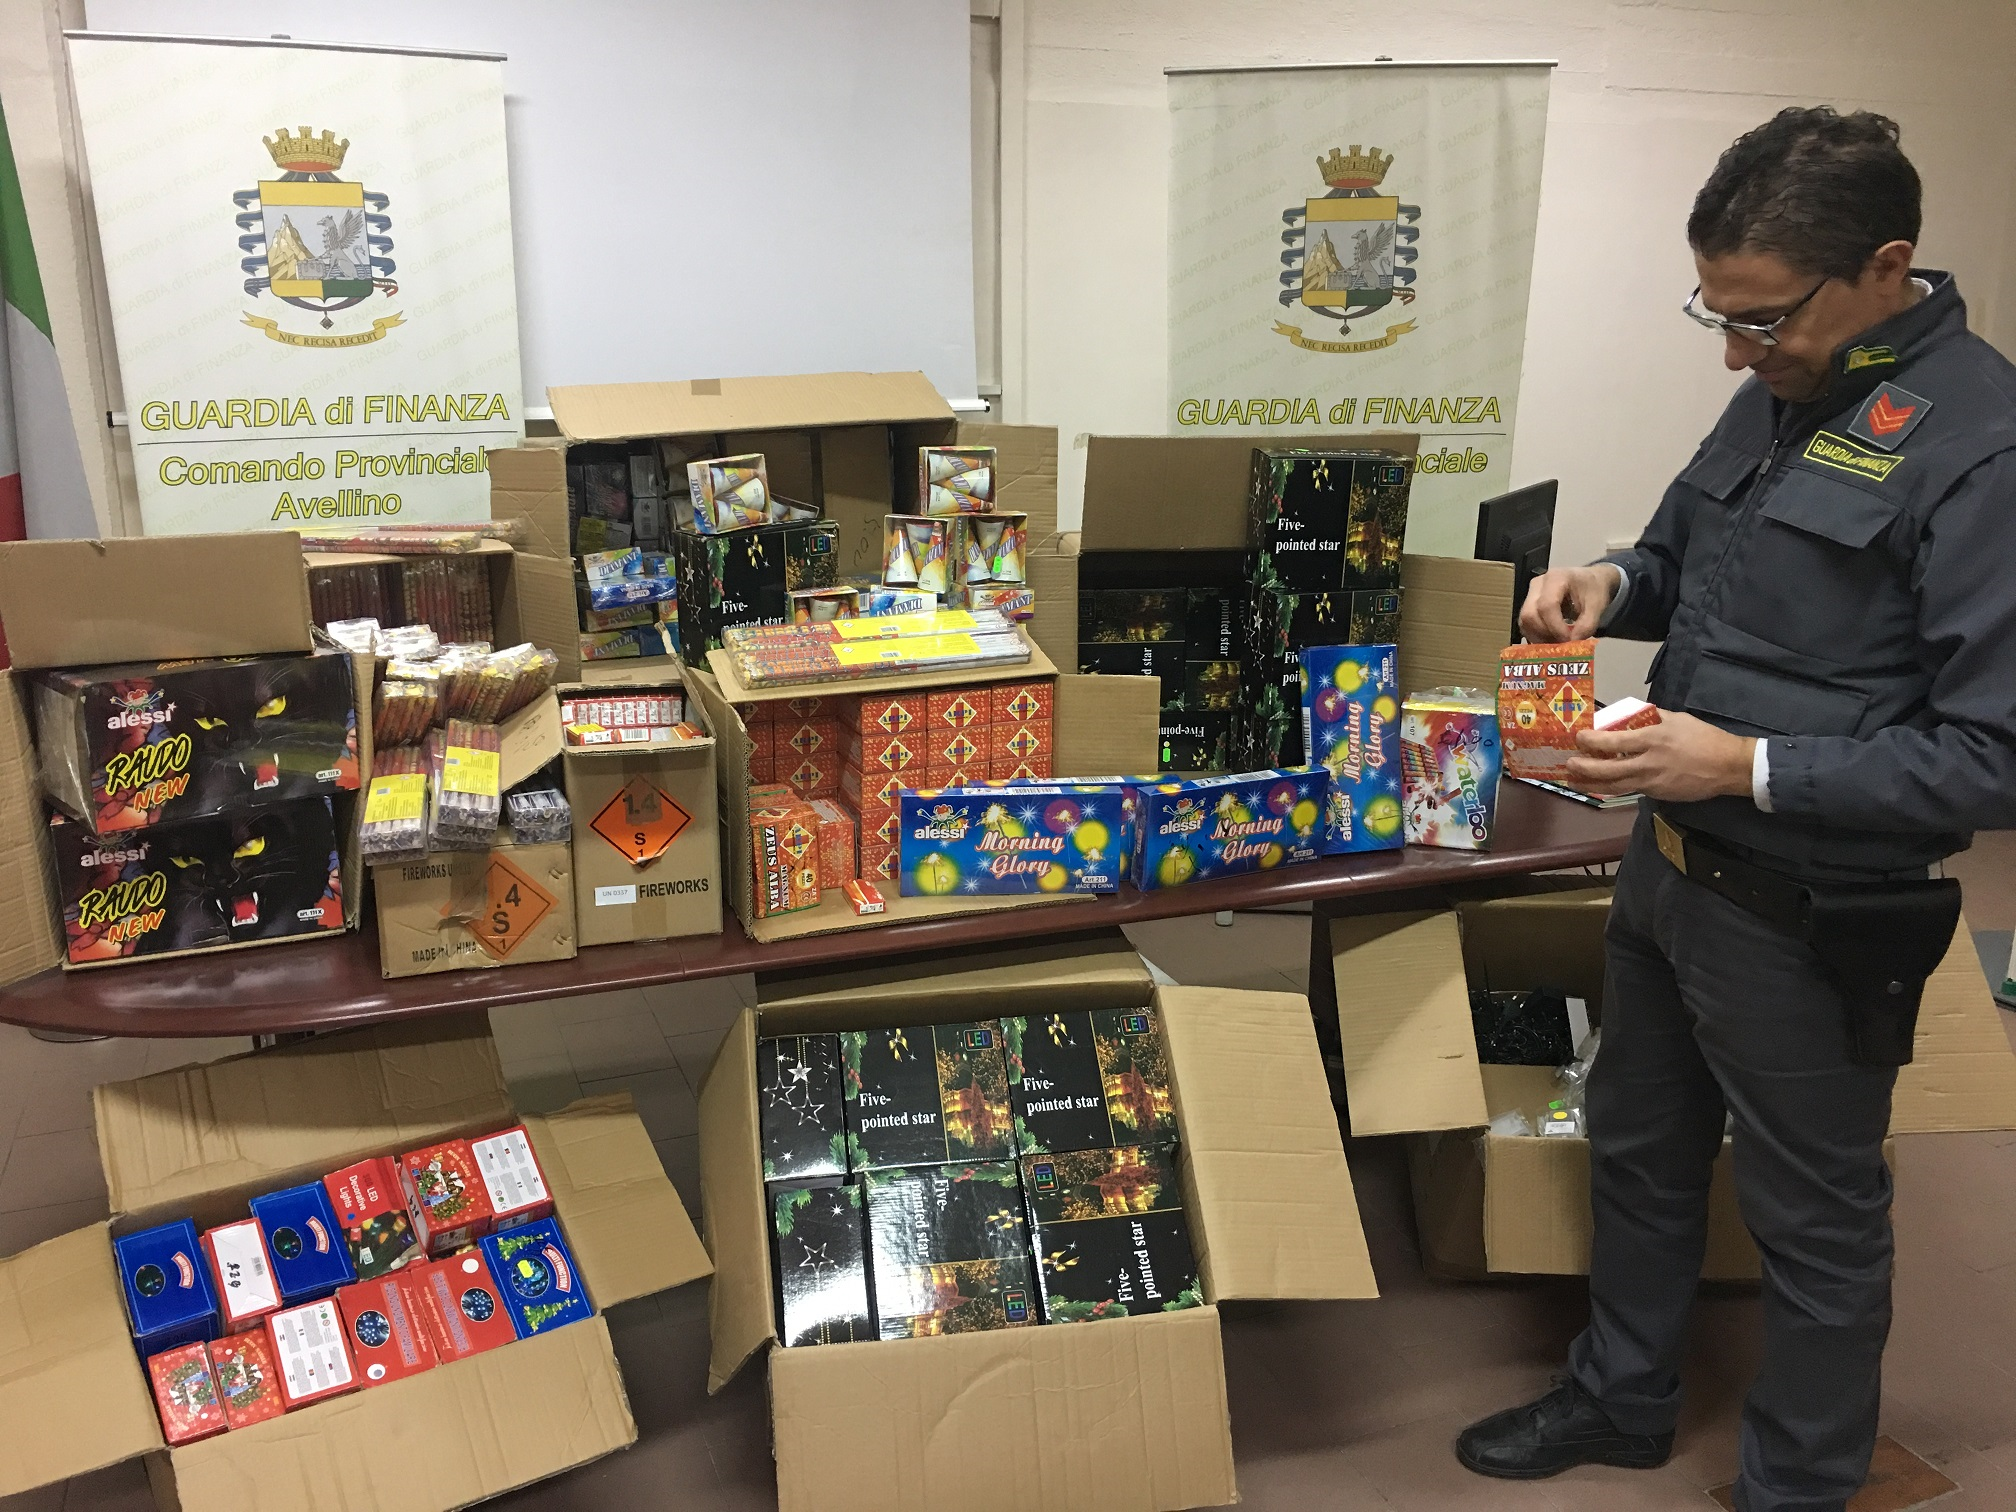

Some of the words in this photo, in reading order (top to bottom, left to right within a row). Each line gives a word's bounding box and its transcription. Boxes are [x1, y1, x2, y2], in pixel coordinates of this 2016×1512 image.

[278, 331, 298, 345] NEC
[302, 336, 337, 348] RECISA
[340, 330, 378, 346] RECEDIT
[1300, 338, 1318, 350] NEC
[1321, 342, 1351, 353] RECISA
[1353, 338, 1389, 352] RECEDIT
[141, 397, 315, 431] GUARDIA
[324, 398, 354, 426] di
[364, 393, 510, 426] FINANZA
[1177, 398, 1321, 425] GUARDIA
[1328, 398, 1356, 425] di
[1363, 397, 1502, 424] FINANZA
[1812, 439, 1853, 464] GUARDIA
[159, 451, 324, 486] Comando
[272, 489, 402, 521] Avellino
[1277, 518, 1305, 531] Five-
[1275, 538, 1316, 554] pointed
[1318, 538, 1341, 551] star
[598, 551, 637, 576] DIAMANT
[722, 600, 748, 614] Five-
[1219, 600, 1232, 635] pointed
[764, 616, 784, 626] star
[1142, 646, 1153, 666] star
[1220, 637, 1229, 657] star
[1284, 651, 1300, 664] Fiv
[1504, 664, 1544, 677] ALBA
[1547, 662, 1589, 676] ZEUS
[1502, 680, 1546, 690] MAGNUM
[107, 706, 174, 730] alessi
[1521, 714, 1532, 725] 40
[1342, 701, 1364, 784] Morning
[1364, 712, 1386, 769] Glory
[105, 733, 192, 795] RAUDO
[134, 772, 190, 812] NEW
[622, 793, 658, 814] 1.4
[1159, 819, 1202, 835] alessi
[1210, 814, 1284, 840] Morning
[1340, 793, 1352, 841] alessi
[634, 832, 646, 846] S
[914, 824, 967, 840] alessi
[975, 830, 1065, 854] Morning
[80, 846, 148, 867] alessi
[638, 848, 644, 857] 1
[765, 826, 778, 866] ZEUS
[1221, 840, 1272, 865] Glory
[402, 864, 447, 882] FIREWORKS
[806, 873, 813, 883] 40
[990, 853, 1052, 880] Glory
[496, 884, 522, 908] .4
[639, 878, 709, 898] FIREWORKS
[768, 870, 782, 911] ALBA
[780, 864, 790, 908] MAGNUM
[78, 871, 167, 929] RAUDO
[108, 908, 166, 944] NEW
[492, 912, 510, 934] S
[412, 949, 436, 963] MADE
[454, 941, 477, 955] HINA
[500, 938, 506, 950] 1
[1122, 1016, 1149, 1034] LED
[967, 1030, 991, 1048] LED
[1022, 1076, 1054, 1092] Five-
[859, 1092, 891, 1108] Five-
[1026, 1096, 1072, 1116] pointed
[1074, 1095, 1099, 1109] star
[861, 1112, 908, 1132] pointed
[912, 1112, 936, 1126] star
[1035, 1165, 1055, 1190] LED
[339, 1186, 352, 1208] Lights
[349, 1174, 367, 1211] Decorative
[366, 1186, 378, 1202] LED
[934, 1178, 949, 1212] Five-
[910, 1181, 930, 1232] pointed
[917, 1232, 930, 1258] star
[1130, 1221, 1147, 1247] star
[556, 1261, 568, 1289] FUNCTION
[1118, 1267, 1134, 1302] Five-
[1134, 1250, 1162, 1300] pointed
[1006, 1293, 1026, 1319] LED
